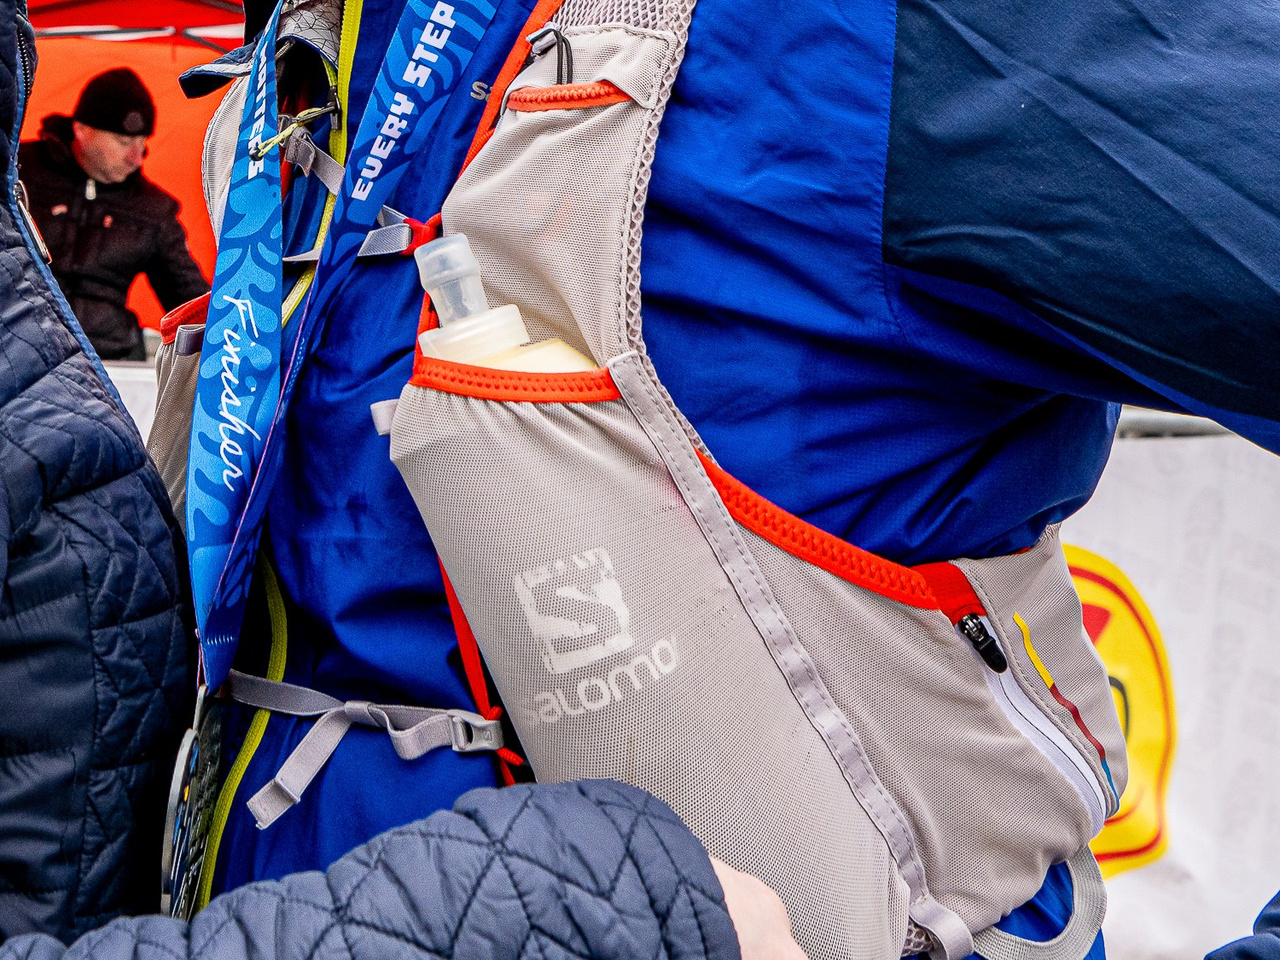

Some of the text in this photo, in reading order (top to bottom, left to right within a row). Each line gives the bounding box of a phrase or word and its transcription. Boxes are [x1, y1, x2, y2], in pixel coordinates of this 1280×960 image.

[352, 91, 416, 202] EVERY
[402, 1, 457, 87] STEP
[220, 293, 261, 492] Finisher
